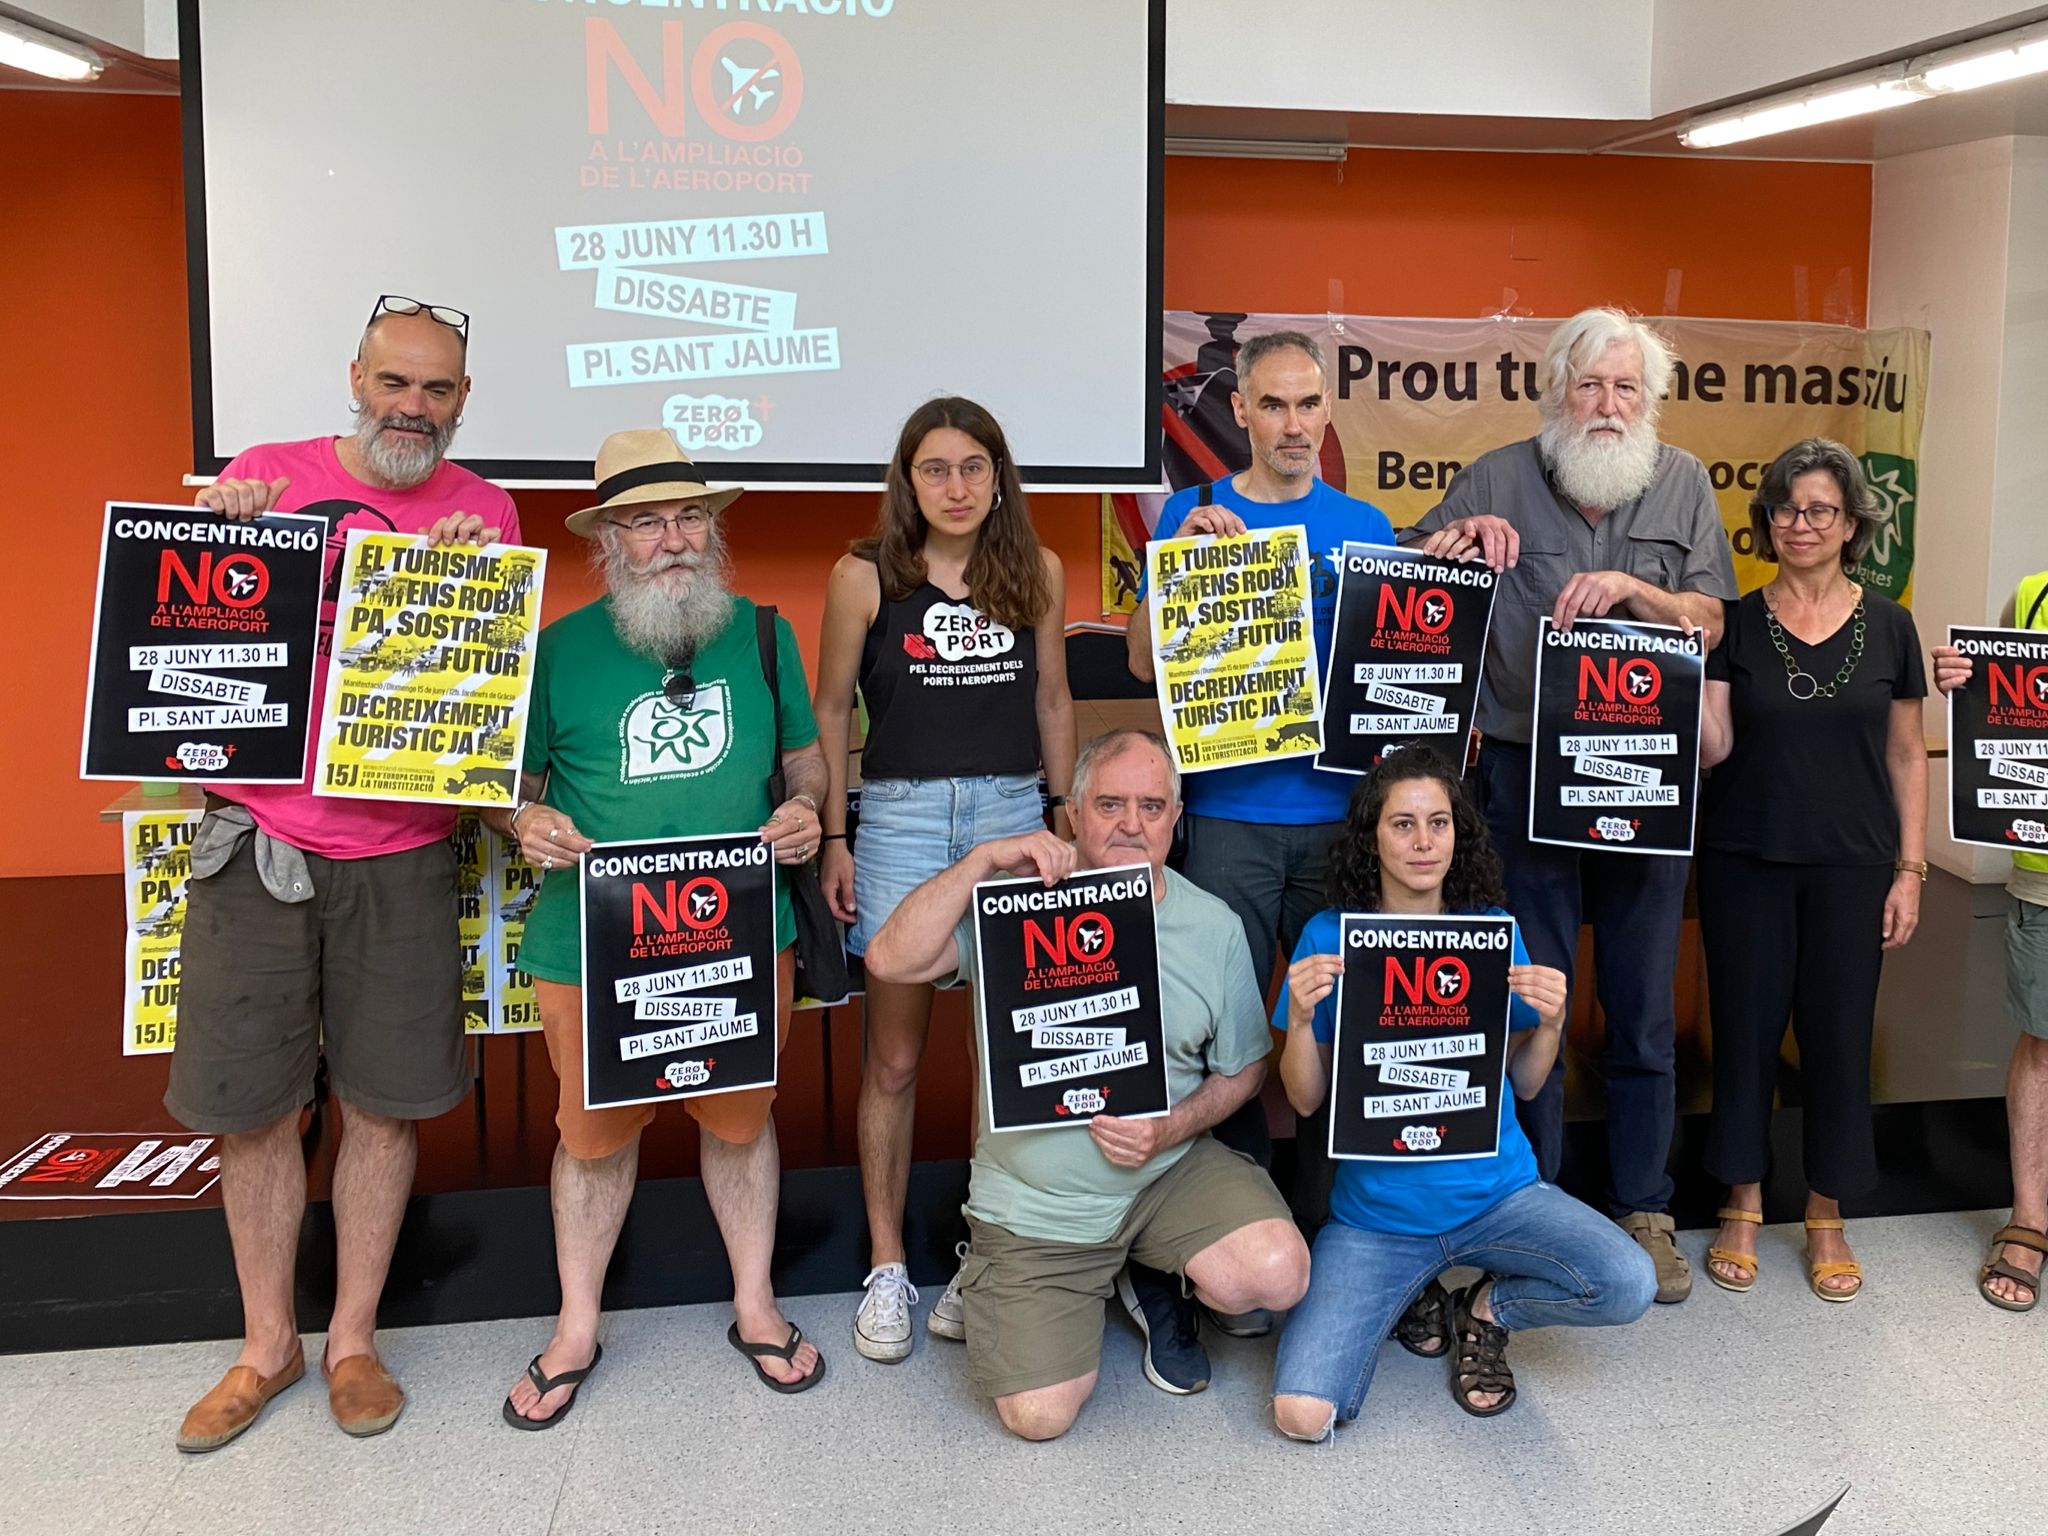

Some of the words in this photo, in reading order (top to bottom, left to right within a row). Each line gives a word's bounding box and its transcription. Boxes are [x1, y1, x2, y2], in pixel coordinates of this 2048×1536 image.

[585, 16, 804, 142] NO
[588, 141, 609, 161] A
[618, 141, 803, 168] L'AMPLIACIÓ
[580, 166, 620, 188] DE
[629, 167, 813, 192] L'AEROPORT
[569, 232, 606, 262] 28
[615, 226, 696, 259] JUNY
[706, 223, 781, 253] 11.30
[791, 219, 812, 247] H
[613, 276, 771, 326] DISSABTE
[632, 342, 715, 374] SANT
[725, 334, 832, 368] JAUME
[1338, 345, 1477, 401] Prou
[673, 405, 741, 423] ZERO
[688, 424, 755, 443] PORT
[115, 519, 318, 550] CONCENTRACIÓ
[359, 544, 384, 571] EL
[392, 547, 502, 583] TURISME
[1160, 552, 1179, 575] EL
[1182, 541, 1272, 572] TURISME
[158, 549, 269, 607] NO
[1200, 572, 1239, 597] ENS
[1243, 566, 1298, 593] ROBA
[1349, 556, 1492, 589] CONCENTRACIÓ
[406, 580, 455, 610] ENS
[458, 585, 525, 616] ROBA
[1376, 583, 1454, 634] NO
[151, 616, 170, 626] DE
[176, 617, 269, 632] L'AEROPORT
[156, 605, 167, 614] A
[171, 605, 266, 620] L'AMPLIACIÓ
[935, 616, 990, 632] ZERO
[1163, 606, 1196, 630] PA,
[1200, 596, 1275, 624] SOSTRE
[351, 607, 392, 637] PA,
[397, 611, 495, 643] SOSTRE
[1239, 621, 1302, 648] FUTUR
[948, 632, 1004, 651] PORT
[1370, 639, 1384, 648] DE
[1387, 641, 1451, 655] L'AEROPORT
[1385, 631, 1449, 644] L'AMPLIACIÓ
[1547, 631, 1698, 654] CONCENTRACIÓ
[139, 651, 158, 665] 28
[164, 650, 212, 664] JUNY
[219, 648, 261, 663] 11.30
[267, 648, 278, 661] H
[440, 646, 520, 677] FUTUR
[910, 665, 927, 673] PEL
[930, 662, 1001, 673] DECREIXEMENT
[1003, 660, 1023, 670] DELS
[923, 676, 953, 685] PORTS
[956, 677, 959, 685] I
[962, 673, 1015, 685] AEROPORTS
[1361, 668, 1374, 679] 28
[1378, 668, 1411, 680] JUNY
[1415, 667, 1443, 679] 11.30
[1448, 667, 1456, 678] H
[1578, 655, 1662, 705] NO
[161, 674, 250, 701] DISSABTE
[1170, 667, 1306, 704] DECREIXEMENT
[340, 693, 513, 728] DECREIXEMENT
[1374, 687, 1435, 711] DISSABTE
[1578, 702, 1586, 710] A
[1589, 702, 1659, 715] L'AMPLIACIÓ
[167, 710, 215, 725] SANT
[221, 708, 282, 724] JAUME
[1173, 699, 1258, 729] TURÍSTIC
[1377, 718, 1410, 730] SANT
[1413, 718, 1455, 729] JAUME
[1575, 711, 1588, 720] DE
[1592, 713, 1662, 725] L'AEROPORT
[337, 722, 444, 753] TURÍSTIC
[1567, 740, 1581, 752] 28
[1585, 739, 1621, 751] JUNY
[1624, 738, 1656, 751] 11.30
[1661, 738, 1670, 750] H
[1981, 743, 1995, 755] 28
[1999, 743, 2032, 755] JUNY
[1177, 742, 1200, 764] 15J
[326, 763, 359, 787] 15J
[409, 775, 435, 783] CONTRA
[1583, 760, 1650, 783] DISSABTE
[361, 780, 371, 788] LA
[373, 779, 434, 792] TURISTITZACIÓ
[1588, 790, 1624, 802] SANT
[1628, 789, 1675, 801] JAUME
[2003, 793, 2037, 805] SANT
[590, 842, 768, 877] CONCENTRACIÓ
[632, 876, 728, 934] NO
[982, 874, 1148, 915] CONCENTRACIÓ
[634, 937, 643, 946] A
[647, 927, 728, 945] L'AMPLIACIÓ
[1023, 912, 1114, 968] NO
[1349, 928, 1508, 950] CONCENTRACIÓ
[631, 948, 648, 958] DE
[651, 939, 733, 956] L'AEROPORT
[624, 982, 640, 997] 28
[646, 973, 687, 993] JUNY
[691, 965, 728, 984] 11.30
[733, 962, 743, 976] H
[1024, 980, 1041, 990] DE
[1045, 971, 1120, 988] L'AEROPORT
[1028, 970, 1035, 979] A
[1039, 959, 1115, 977] L'AMPLIACIÓ
[1384, 956, 1471, 1005] NO
[503, 1004, 530, 1024] 15J
[644, 1003, 722, 1016] DISSABTE
[1020, 1013, 1036, 1027] 28
[1041, 1004, 1078, 1023] JUNY
[1082, 995, 1117, 1015] 11.30
[1121, 993, 1131, 1006] H
[1380, 1017, 1395, 1025] DE
[1399, 1016, 1471, 1026] L'AEROPORT
[1384, 1006, 1392, 1015] A
[1395, 1005, 1468, 1015] L'AMPLIACIÓ
[136, 1022, 165, 1044] 15J
[653, 1029, 695, 1050] SANT
[700, 1018, 753, 1040] JAUME
[1041, 1032, 1114, 1046] DISSABTE
[1371, 1047, 1385, 1060] 28
[1391, 1043, 1427, 1059] JUNY
[1431, 1040, 1465, 1054] 11.30
[1469, 1038, 1477, 1051] H
[1051, 1058, 1089, 1077] SANT
[1094, 1047, 1143, 1069] JAUME
[1388, 1068, 1456, 1087] DISSABTE
[1393, 1096, 1430, 1112] SANT
[1435, 1091, 1481, 1108] JAUME
